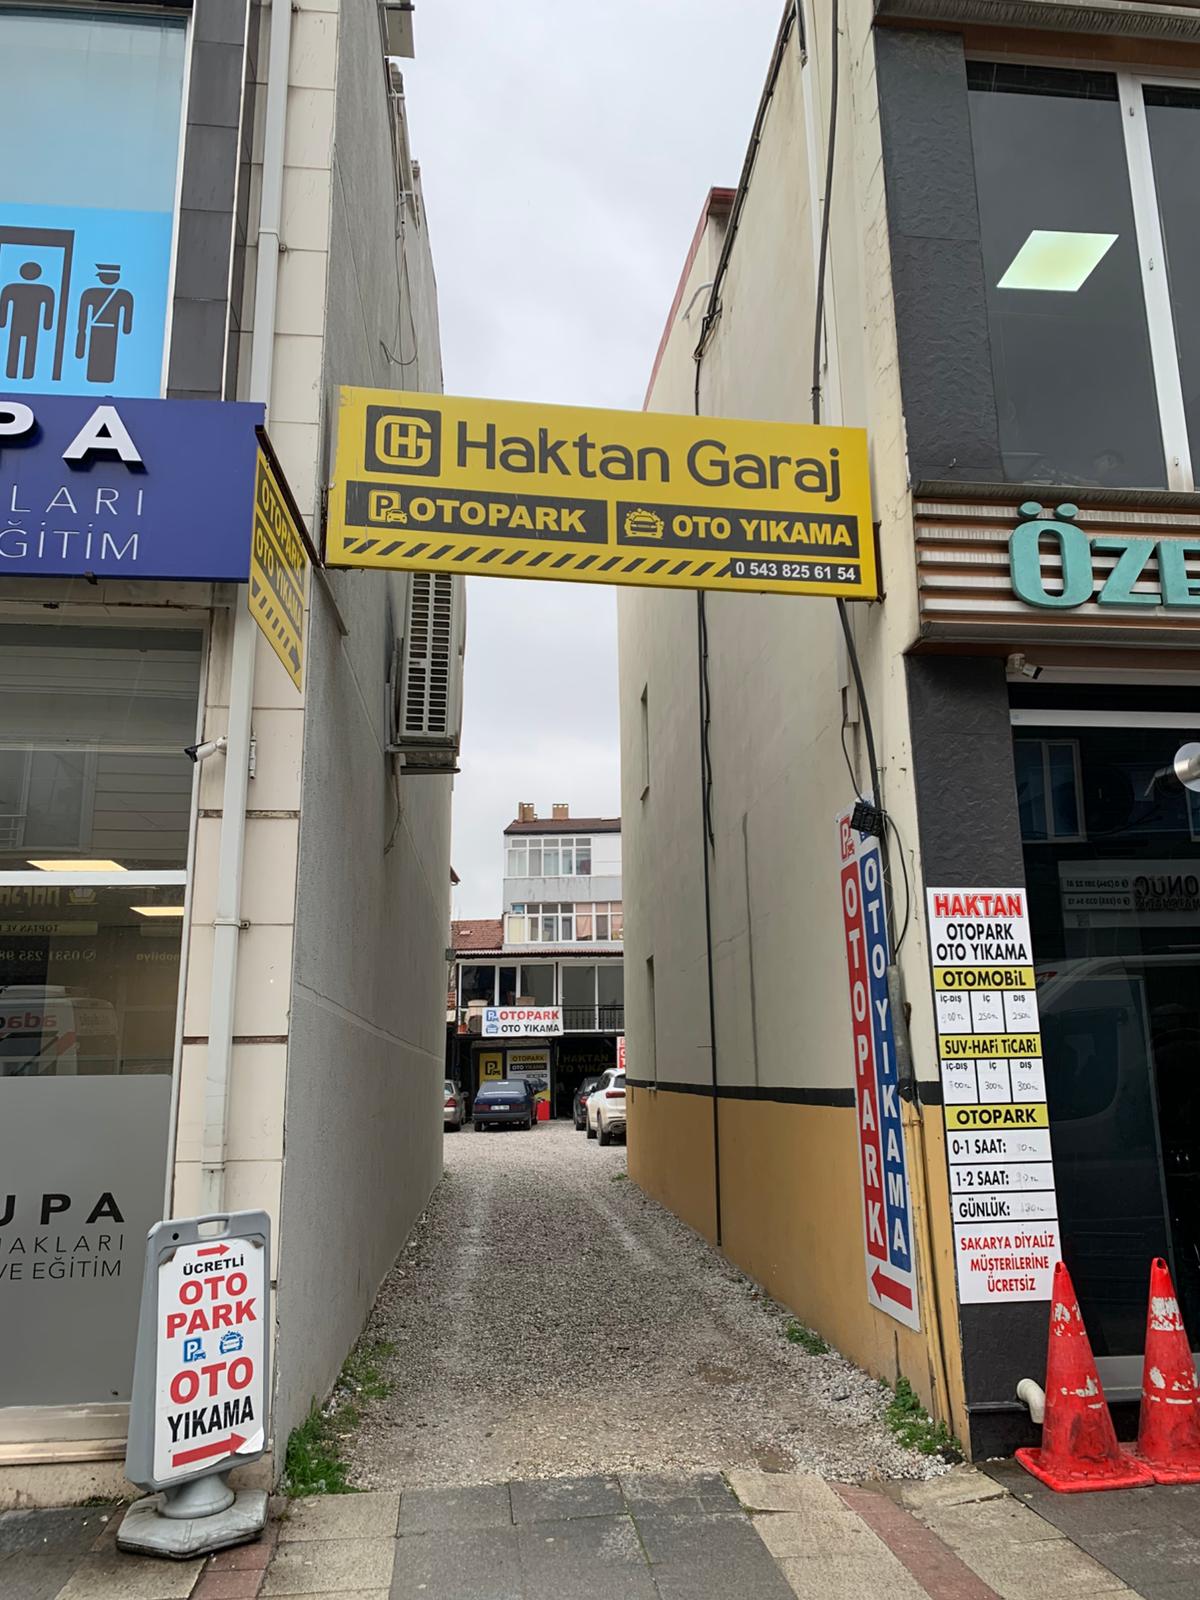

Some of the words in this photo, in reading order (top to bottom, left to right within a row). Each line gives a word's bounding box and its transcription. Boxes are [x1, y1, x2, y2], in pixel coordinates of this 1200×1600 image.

[457, 420, 670, 483] Haktan
[686, 438, 841, 502] Garaj
[408, 496, 587, 533] OTOPARK
[261, 478, 303, 581] OTOPARK
[671, 513, 732, 540] OTO
[739, 517, 853, 547] YIKAMA
[256, 526, 273, 577] OTO
[735, 560, 745, 575] 0
[749, 561, 778, 577] 543
[781, 563, 810, 578] 825
[813, 565, 831, 579] 61
[837, 566, 856, 581] 54
[933, 893, 1024, 918] HAKTAN
[946, 923, 1014, 941] OTOPARK
[936, 943, 967, 961] OTO
[970, 943, 1028, 961] YIKAMA
[1013, 993, 1026, 1003] DIŞ
[500, 1010, 559, 1020] OTOPARK
[501, 1024, 521, 1033] OTO
[524, 1024, 560, 1033] YIKAMA
[844, 877, 885, 1247] OTOPARK
[864, 856, 886, 979] OTO
[875, 997, 908, 1256] YIKAMA
[1019, 1060, 1033, 1070] DIŞ
[956, 1108, 1037, 1125] OTOPARK
[952, 1139, 970, 1155] 0-1
[974, 1138, 1007, 1154] SAAT:
[956, 1171, 974, 1187] 1-2
[977, 1170, 1010, 1186] SAAT:
[958, 1197, 1011, 1218] GÜNLÜK:
[0, 1234, 124, 1254] AKLARI
[961, 1235, 1011, 1251] SAKARYA
[1014, 1230, 1055, 1250] DİYALİZ
[32, 1256, 122, 1280] EĞİTİM
[183, 1253, 245, 1276] ÜCRETLİ
[970, 1252, 1049, 1274] MÜŞTERİLERİNE
[178, 1272, 249, 1306] OTO
[987, 1275, 1036, 1293] ÜCRETSİZ
[166, 1297, 257, 1339] PARK
[169, 1356, 254, 1405] OTO
[167, 1395, 254, 1443] YIKAMA
